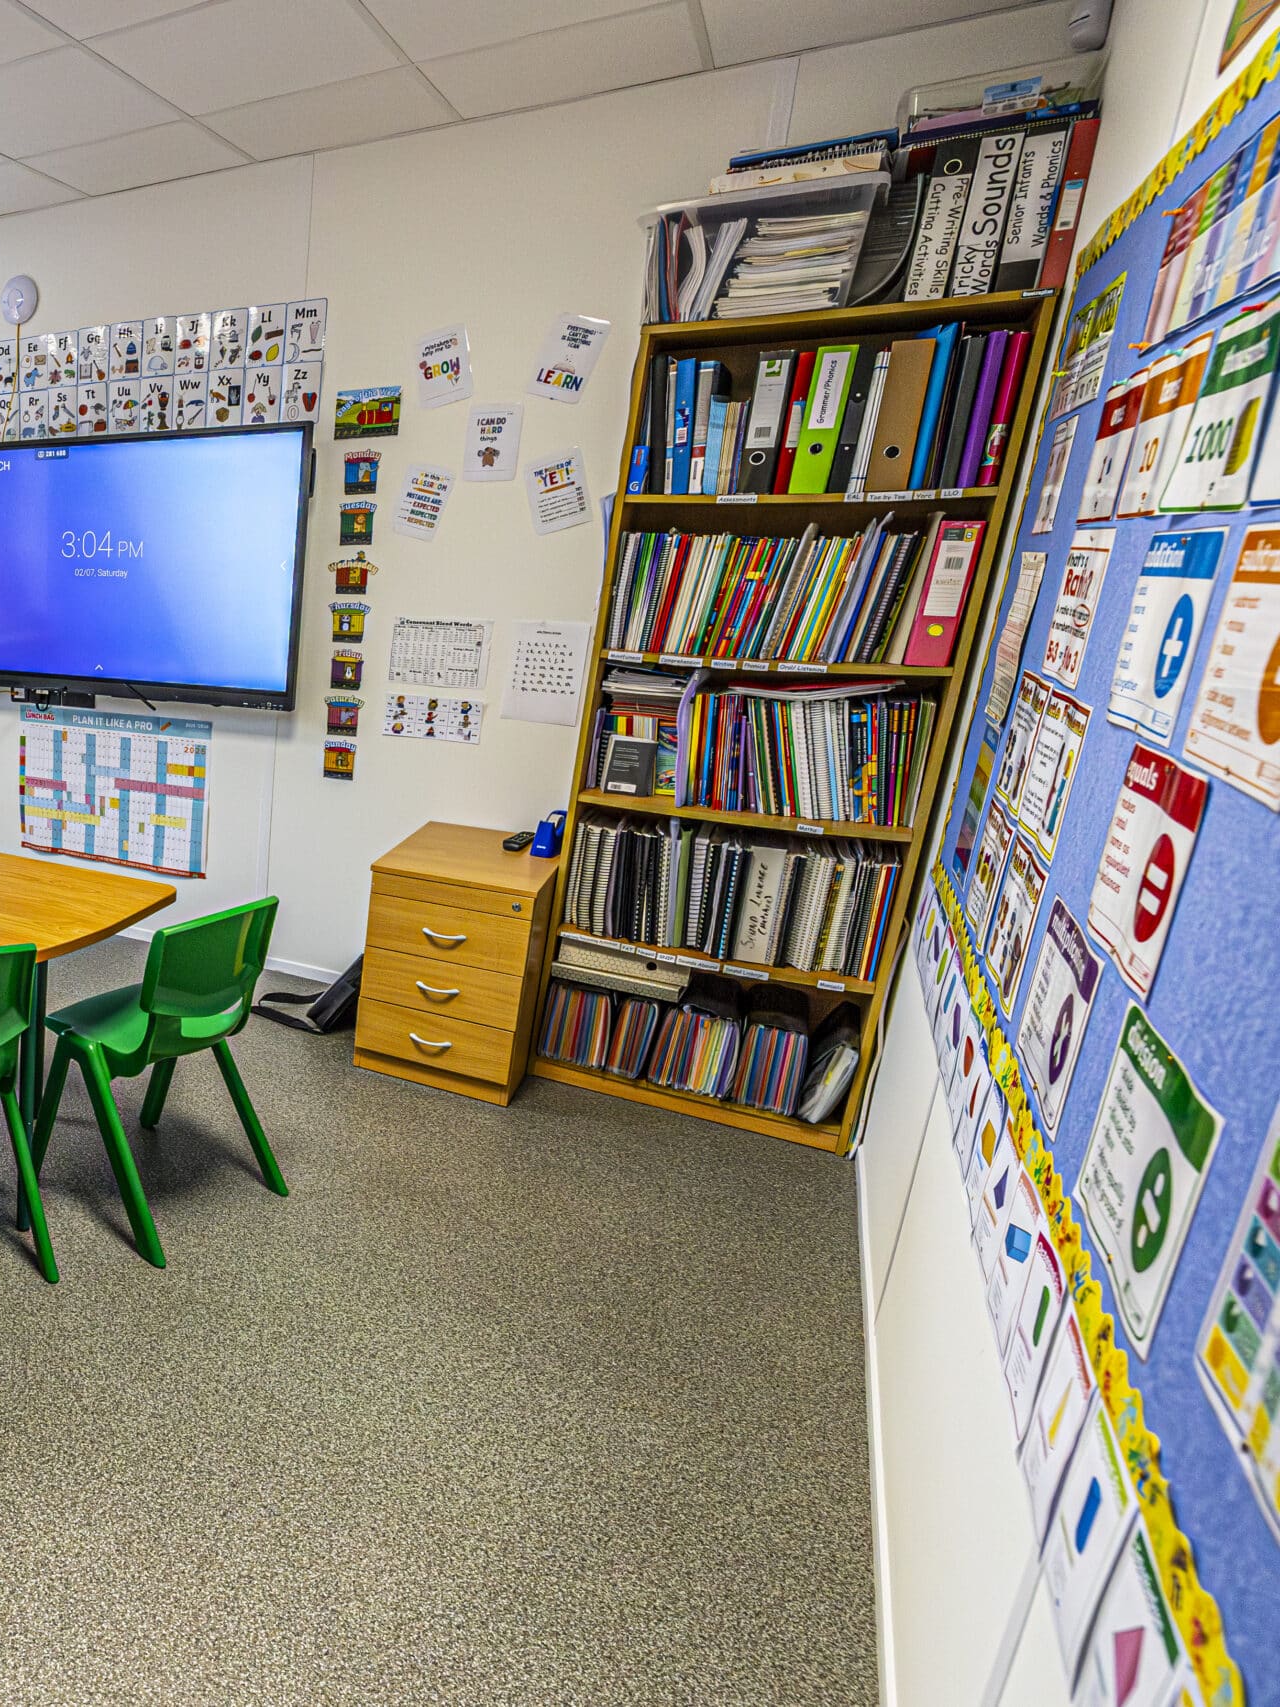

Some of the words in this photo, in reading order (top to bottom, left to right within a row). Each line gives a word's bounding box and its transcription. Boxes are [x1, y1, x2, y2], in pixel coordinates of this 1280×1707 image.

[1041, 140, 1063, 190] Phonics
[1015, 150, 1036, 200] Infants
[972, 138, 1016, 236] Sounds
[1040, 192, 1052, 202] &
[920, 183, 946, 230] Cutting
[936, 177, 970, 259] Pre-Writing
[1008, 205, 1026, 244] Senior
[1030, 210, 1050, 248] Words
[908, 236, 930, 296] Activities
[952, 246, 979, 298] Tricky
[970, 240, 999, 296] Words
[926, 260, 948, 298] Skills,
[28, 343, 38, 353] Ee
[58, 338, 70, 350] Ff
[188, 320, 199, 332] Jj
[261, 311, 272, 324] Ll
[295, 307, 318, 320] Mm
[424, 357, 460, 380] GROW
[29, 396, 40, 406] Rr
[56, 392, 68, 402] Ss
[85, 390, 96, 400] Tt
[118, 386, 130, 396] Uu
[149, 384, 163, 393] Vv
[180, 380, 201, 390] Ww
[218, 375, 232, 386] Xx
[256, 373, 270, 386] Yy
[294, 369, 308, 380] Zz
[536, 368, 584, 392] LEARN
[336, 399, 355, 418] Days
[355, 393, 364, 402] of
[364, 388, 378, 398] the
[480, 418, 495, 426] CAN
[480, 426, 502, 434] HARD
[1184, 417, 1234, 464] 1000
[344, 449, 382, 462] Monday
[1138, 437, 1160, 474] 10
[540, 467, 570, 488] YET!
[339, 500, 378, 513] Tuesday
[406, 492, 430, 503] MISTAKES
[412, 501, 440, 512] EXPECTED
[406, 516, 436, 528] RESPECTED
[410, 508, 438, 521] INSPECTED
[60, 530, 113, 559] 3:04
[118, 541, 144, 558] PM
[74, 568, 97, 578] 02/07,
[97, 568, 128, 579] Saturday
[328, 558, 380, 575] Wednesday
[328, 602, 372, 614] Thursday
[333, 650, 363, 661] Friday
[661, 656, 702, 666] Comprehension
[713, 660, 735, 668] Writing
[744, 662, 766, 670] Phonics
[796, 665, 826, 674] Listening
[324, 694, 366, 710] Saturday
[25, 711, 42, 720] LUNCH
[43, 712, 55, 721] BAG
[72, 714, 94, 725] PLAN
[96, 717, 104, 726] IT
[105, 718, 124, 728] LIKE
[126, 720, 132, 728] A
[134, 721, 153, 732] PRO
[324, 740, 358, 752] Sunday
